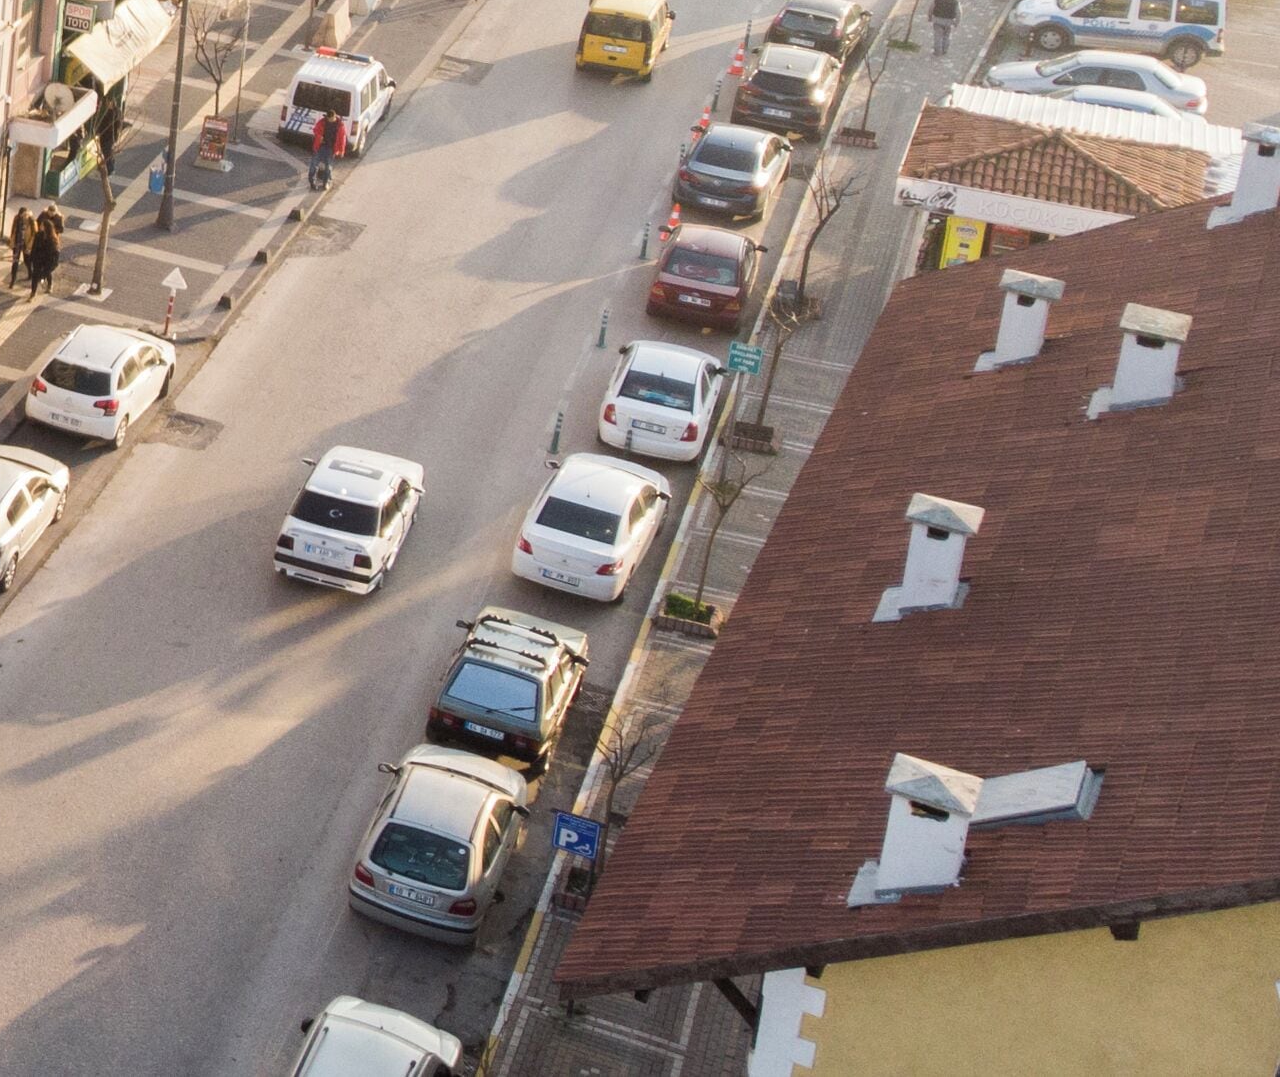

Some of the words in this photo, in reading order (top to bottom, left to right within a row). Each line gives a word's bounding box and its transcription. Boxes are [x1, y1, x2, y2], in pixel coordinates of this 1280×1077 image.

[68, 5, 91, 18] SPOR
[67, 17, 89, 29] TOTO
[559, 828, 578, 846] P
